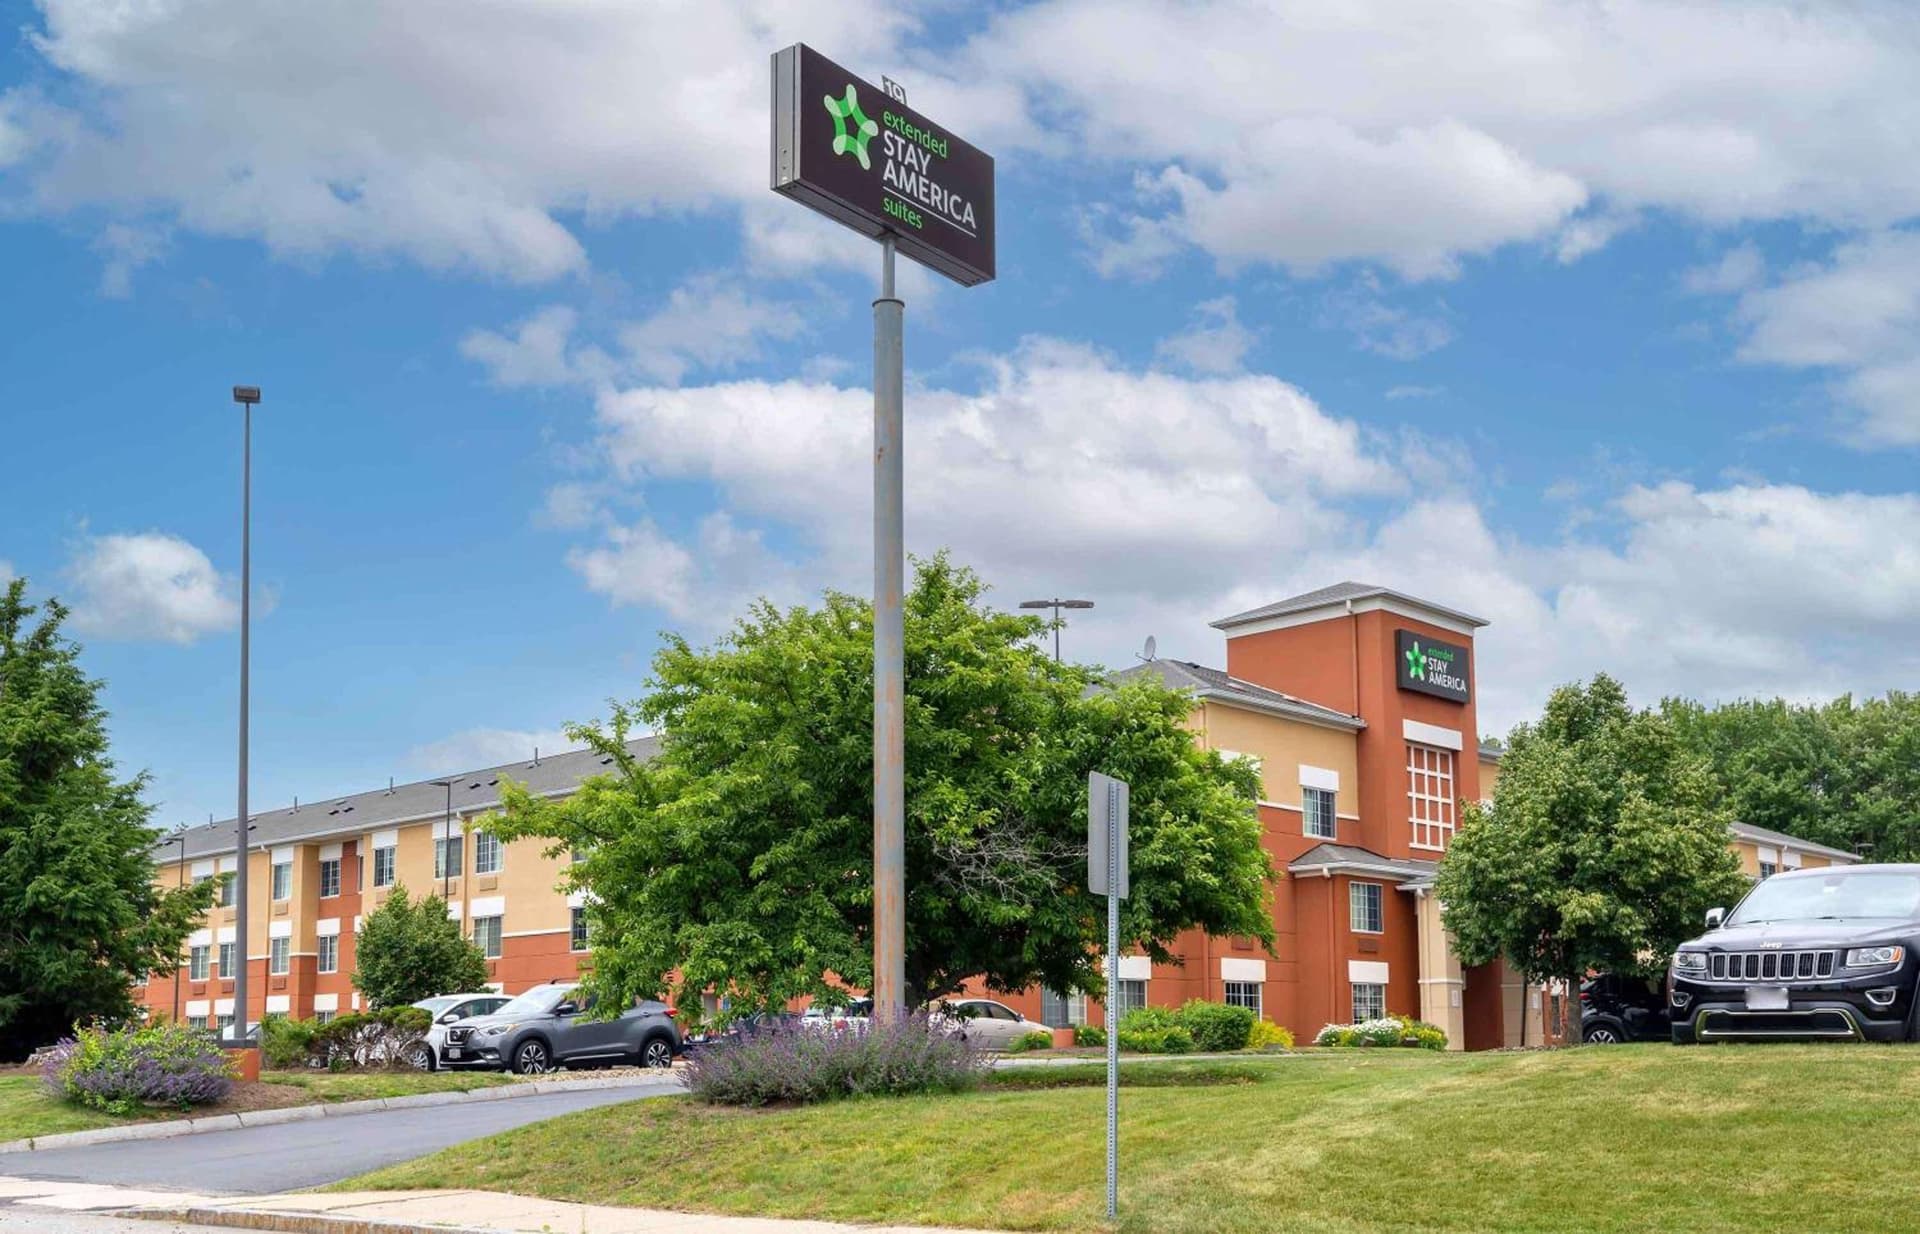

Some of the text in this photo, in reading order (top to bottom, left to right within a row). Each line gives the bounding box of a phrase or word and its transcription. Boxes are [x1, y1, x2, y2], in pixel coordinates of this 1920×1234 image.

[884, 111, 947, 158] extended
[883, 130, 931, 175] STAY
[883, 159, 977, 229] AMERICA
[883, 198, 922, 229] suites
[1428, 657, 1448, 673] STAY
[1429, 672, 1466, 692] AMERICA
[1760, 941, 1783, 949] Jeep
